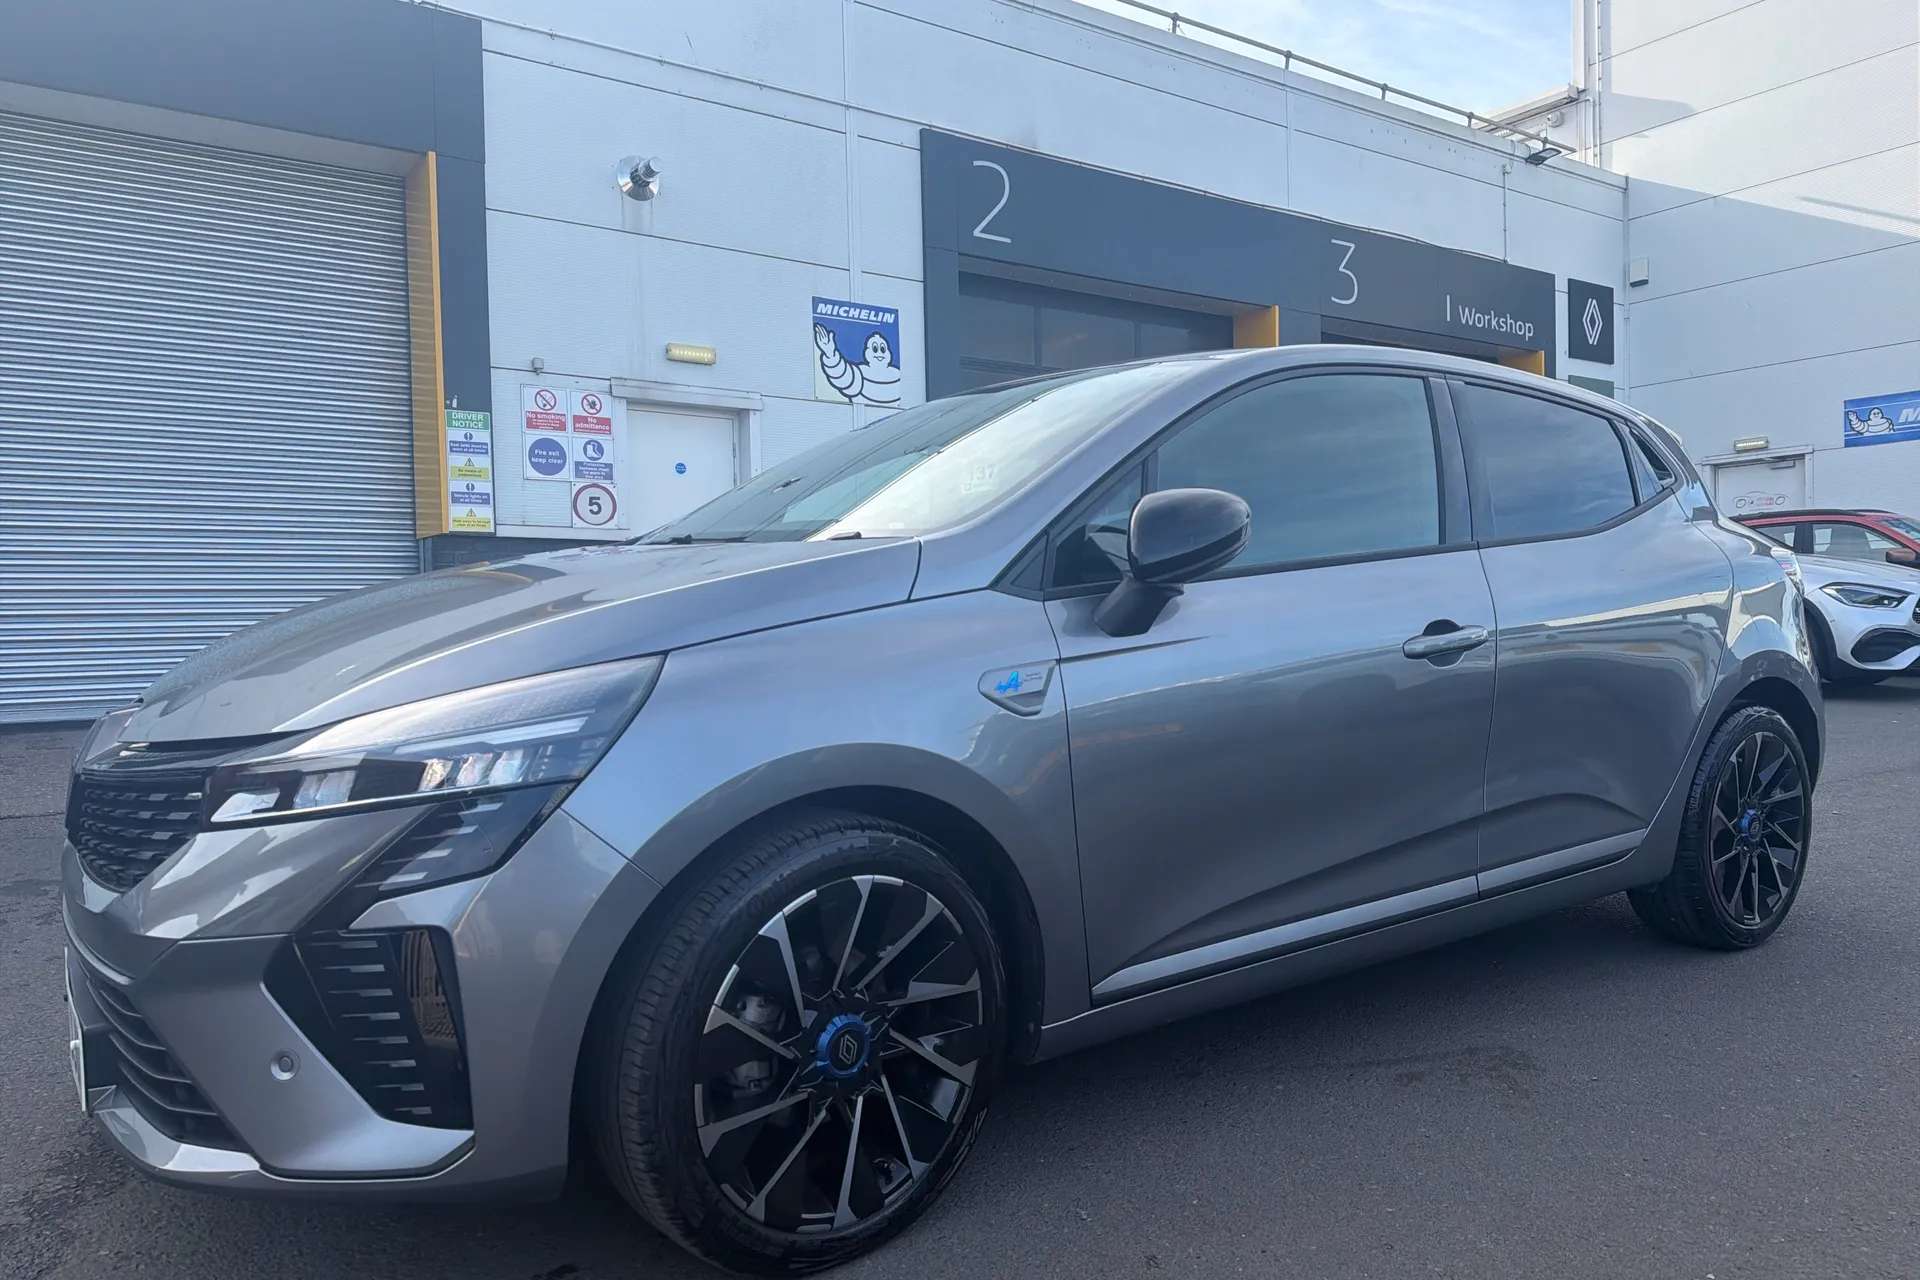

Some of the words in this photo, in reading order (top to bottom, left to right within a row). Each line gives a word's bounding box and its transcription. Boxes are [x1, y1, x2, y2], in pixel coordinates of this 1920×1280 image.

[972, 160, 1012, 243] 2
[1330, 239, 1359, 305] 3
[816, 303, 896, 324] MICHELIN
[1458, 304, 1535, 341] Workshop
[452, 411, 484, 421] DRIVER
[452, 420, 484, 429] NOTICE
[537, 412, 566, 422] smoking
[588, 496, 602, 515] 5
